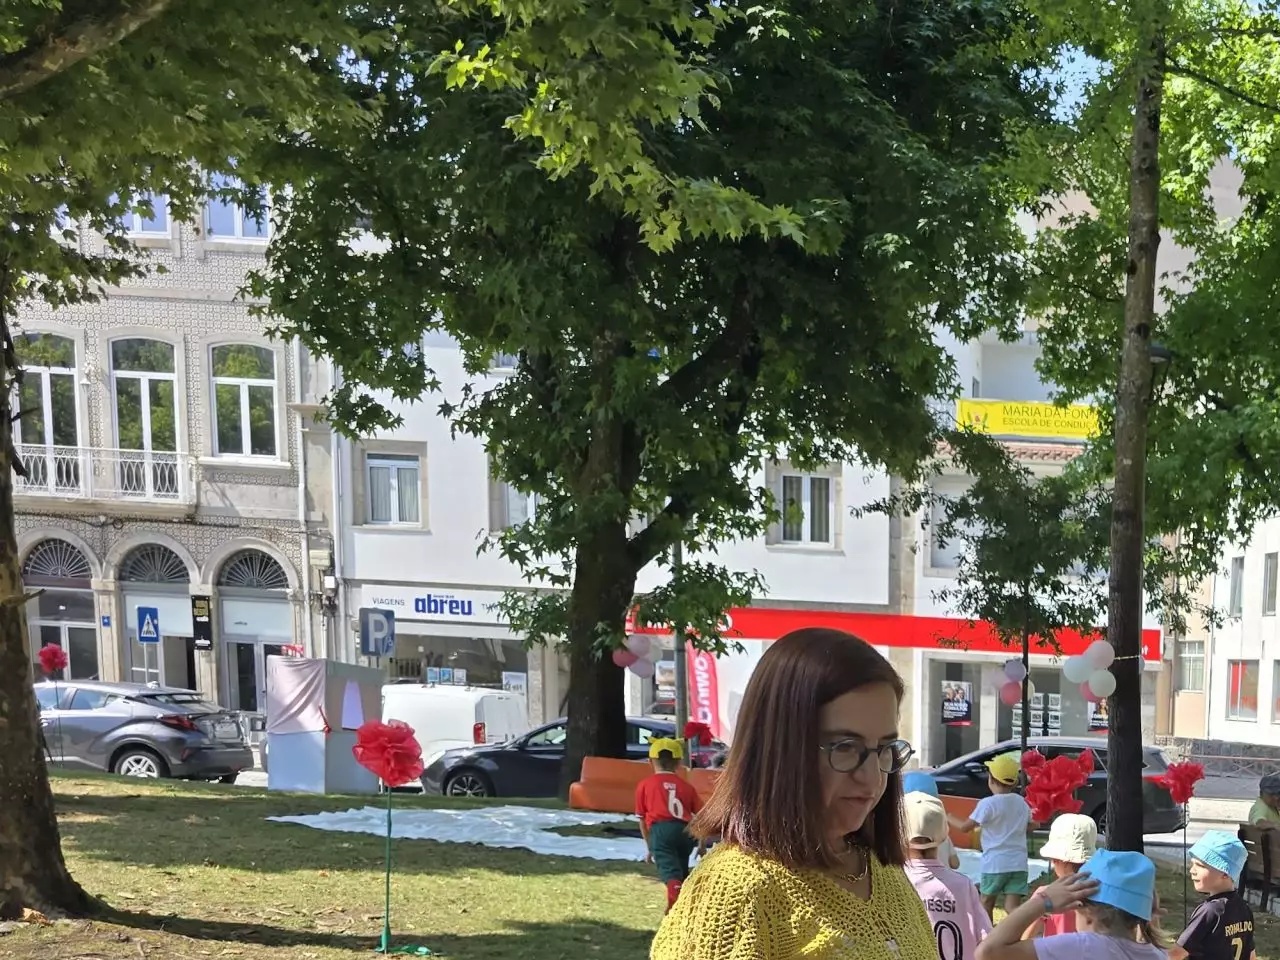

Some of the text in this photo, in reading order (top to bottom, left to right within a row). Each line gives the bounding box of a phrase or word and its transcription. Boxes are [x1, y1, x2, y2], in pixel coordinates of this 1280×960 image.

[1003, 405, 1041, 417] MARIA
[1044, 406, 1061, 418] DA
[1003, 417, 1037, 427] ESCOLA
[1040, 418, 1050, 428] DE
[372, 597, 405, 606] VIAGENS
[414, 594, 472, 616] abreu
[368, 613, 388, 652] P
[668, 790, 683, 819] 6
